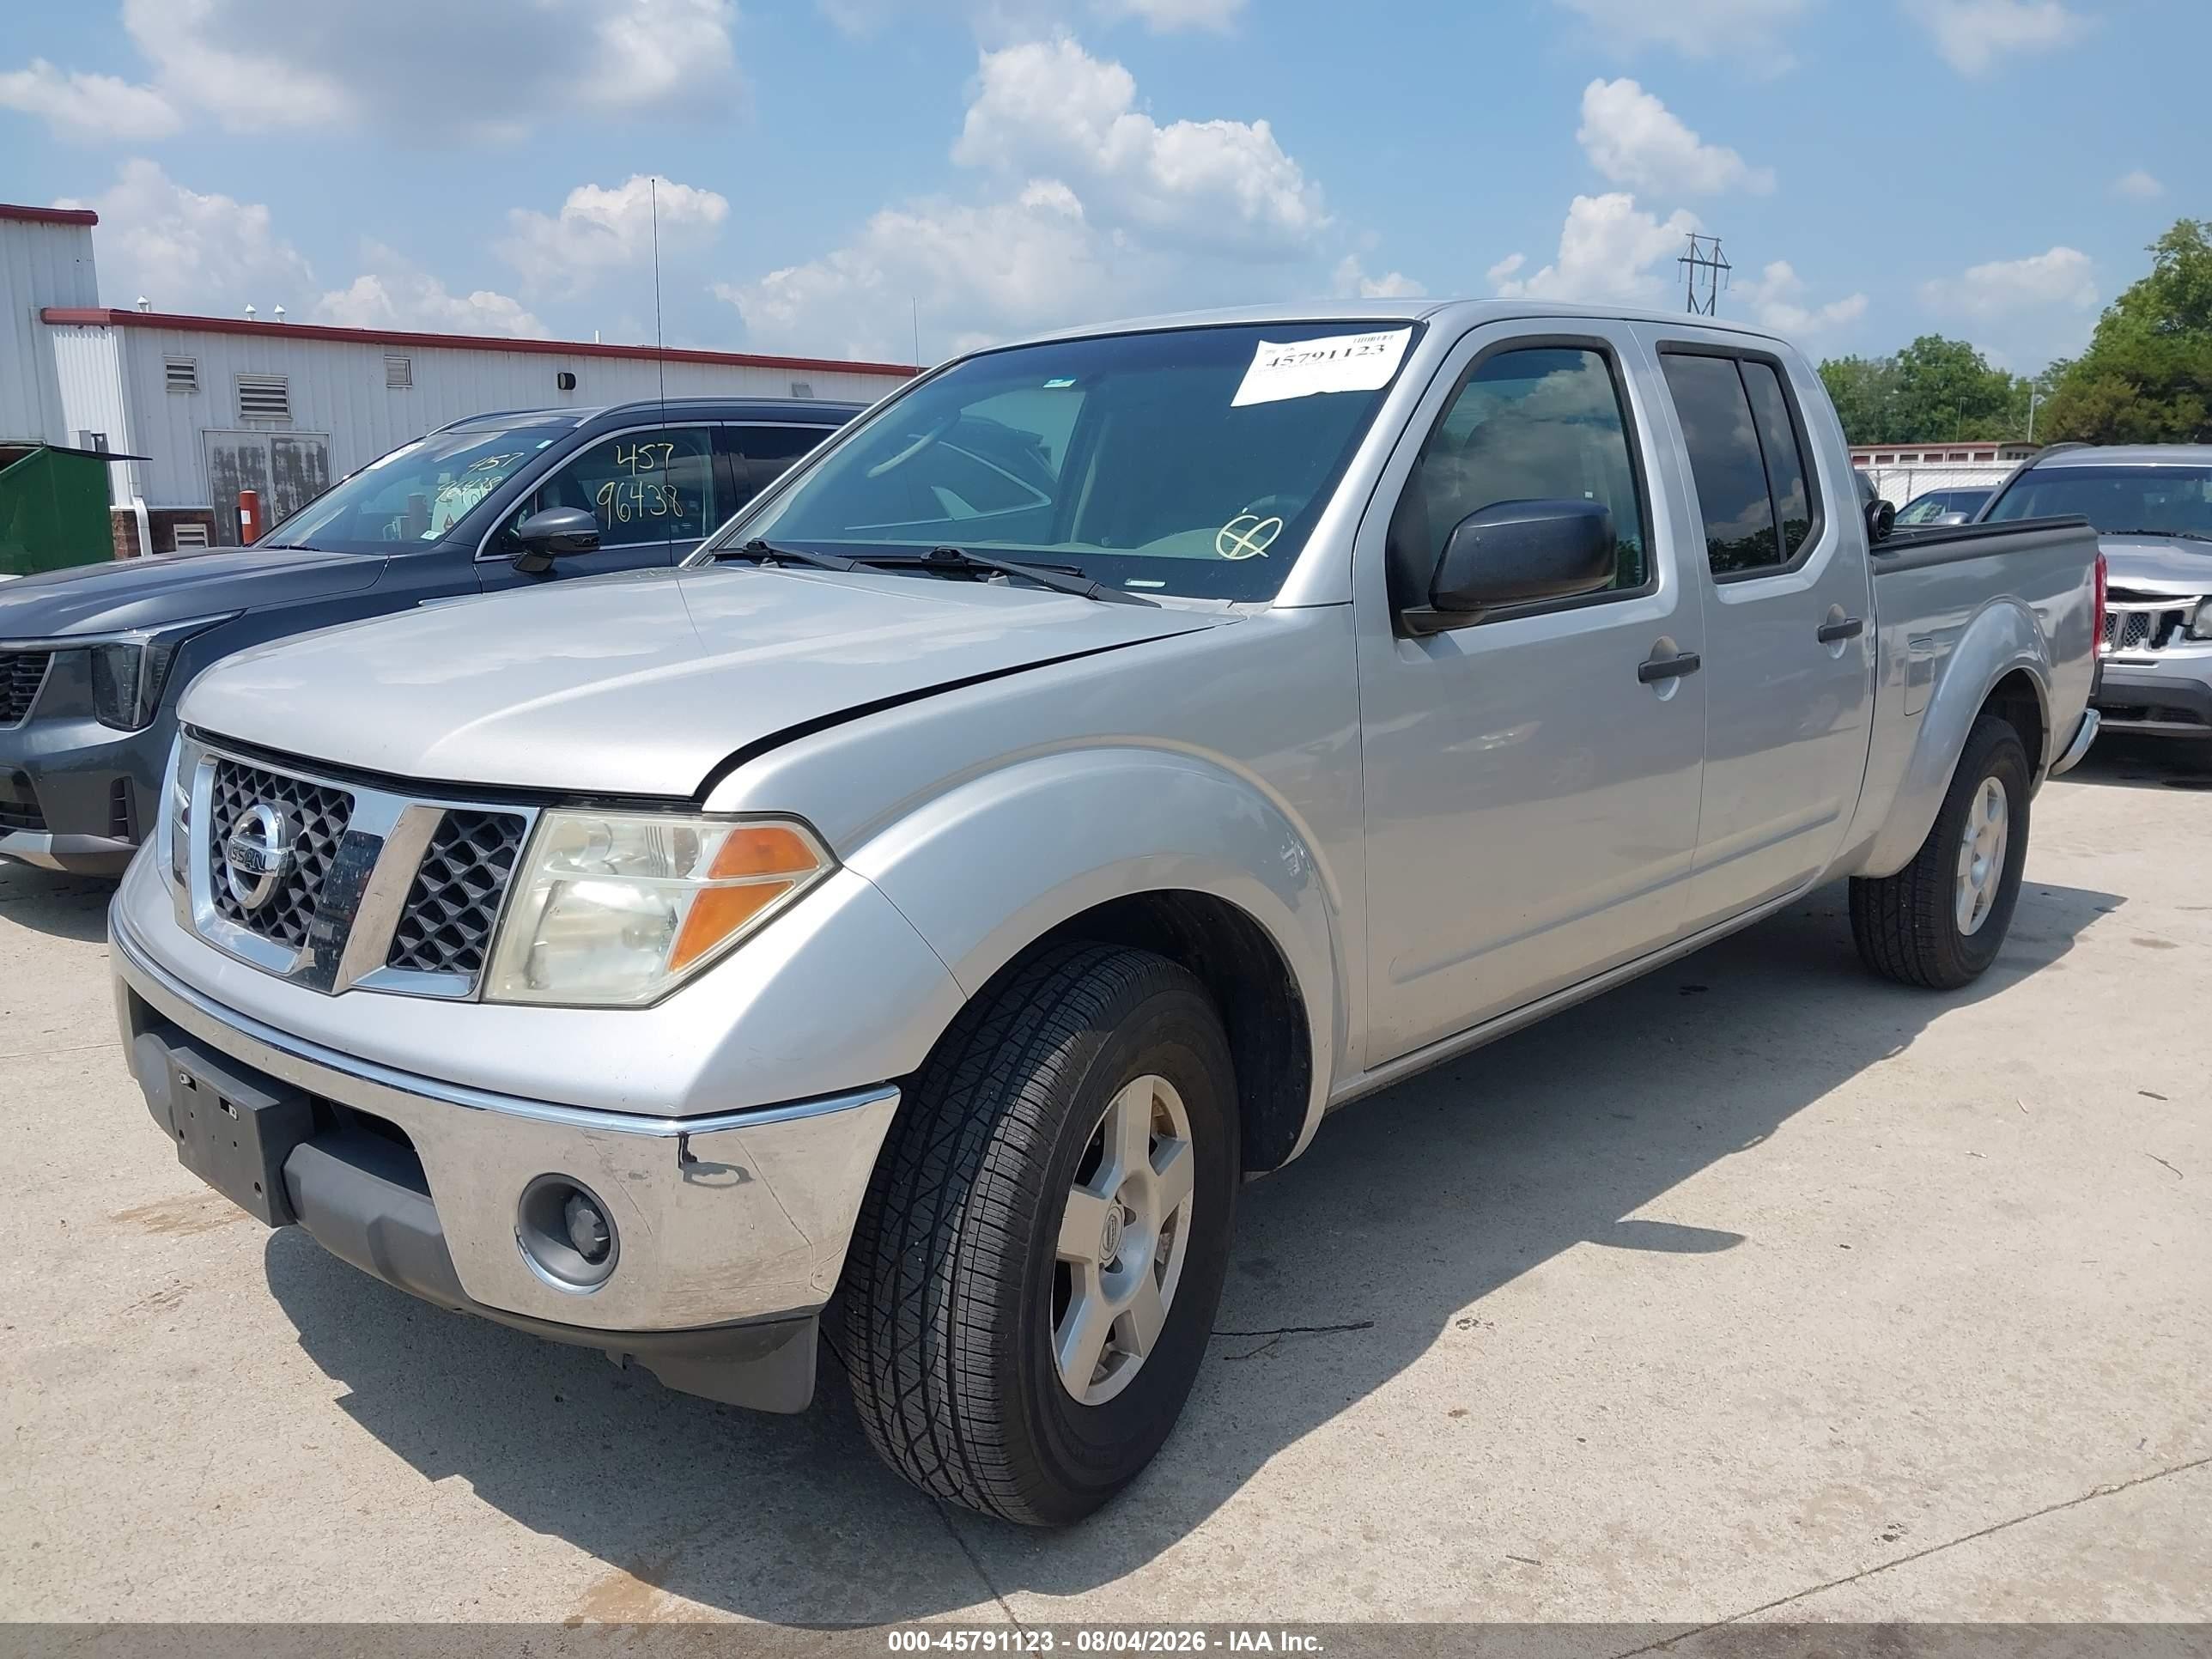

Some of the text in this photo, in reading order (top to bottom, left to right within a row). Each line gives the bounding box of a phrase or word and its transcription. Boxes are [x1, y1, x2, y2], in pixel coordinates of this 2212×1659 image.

[1266, 344, 1386, 368] 45791123
[466, 452, 525, 474] 457
[616, 443, 674, 477] 457
[596, 481, 684, 530] 96438
